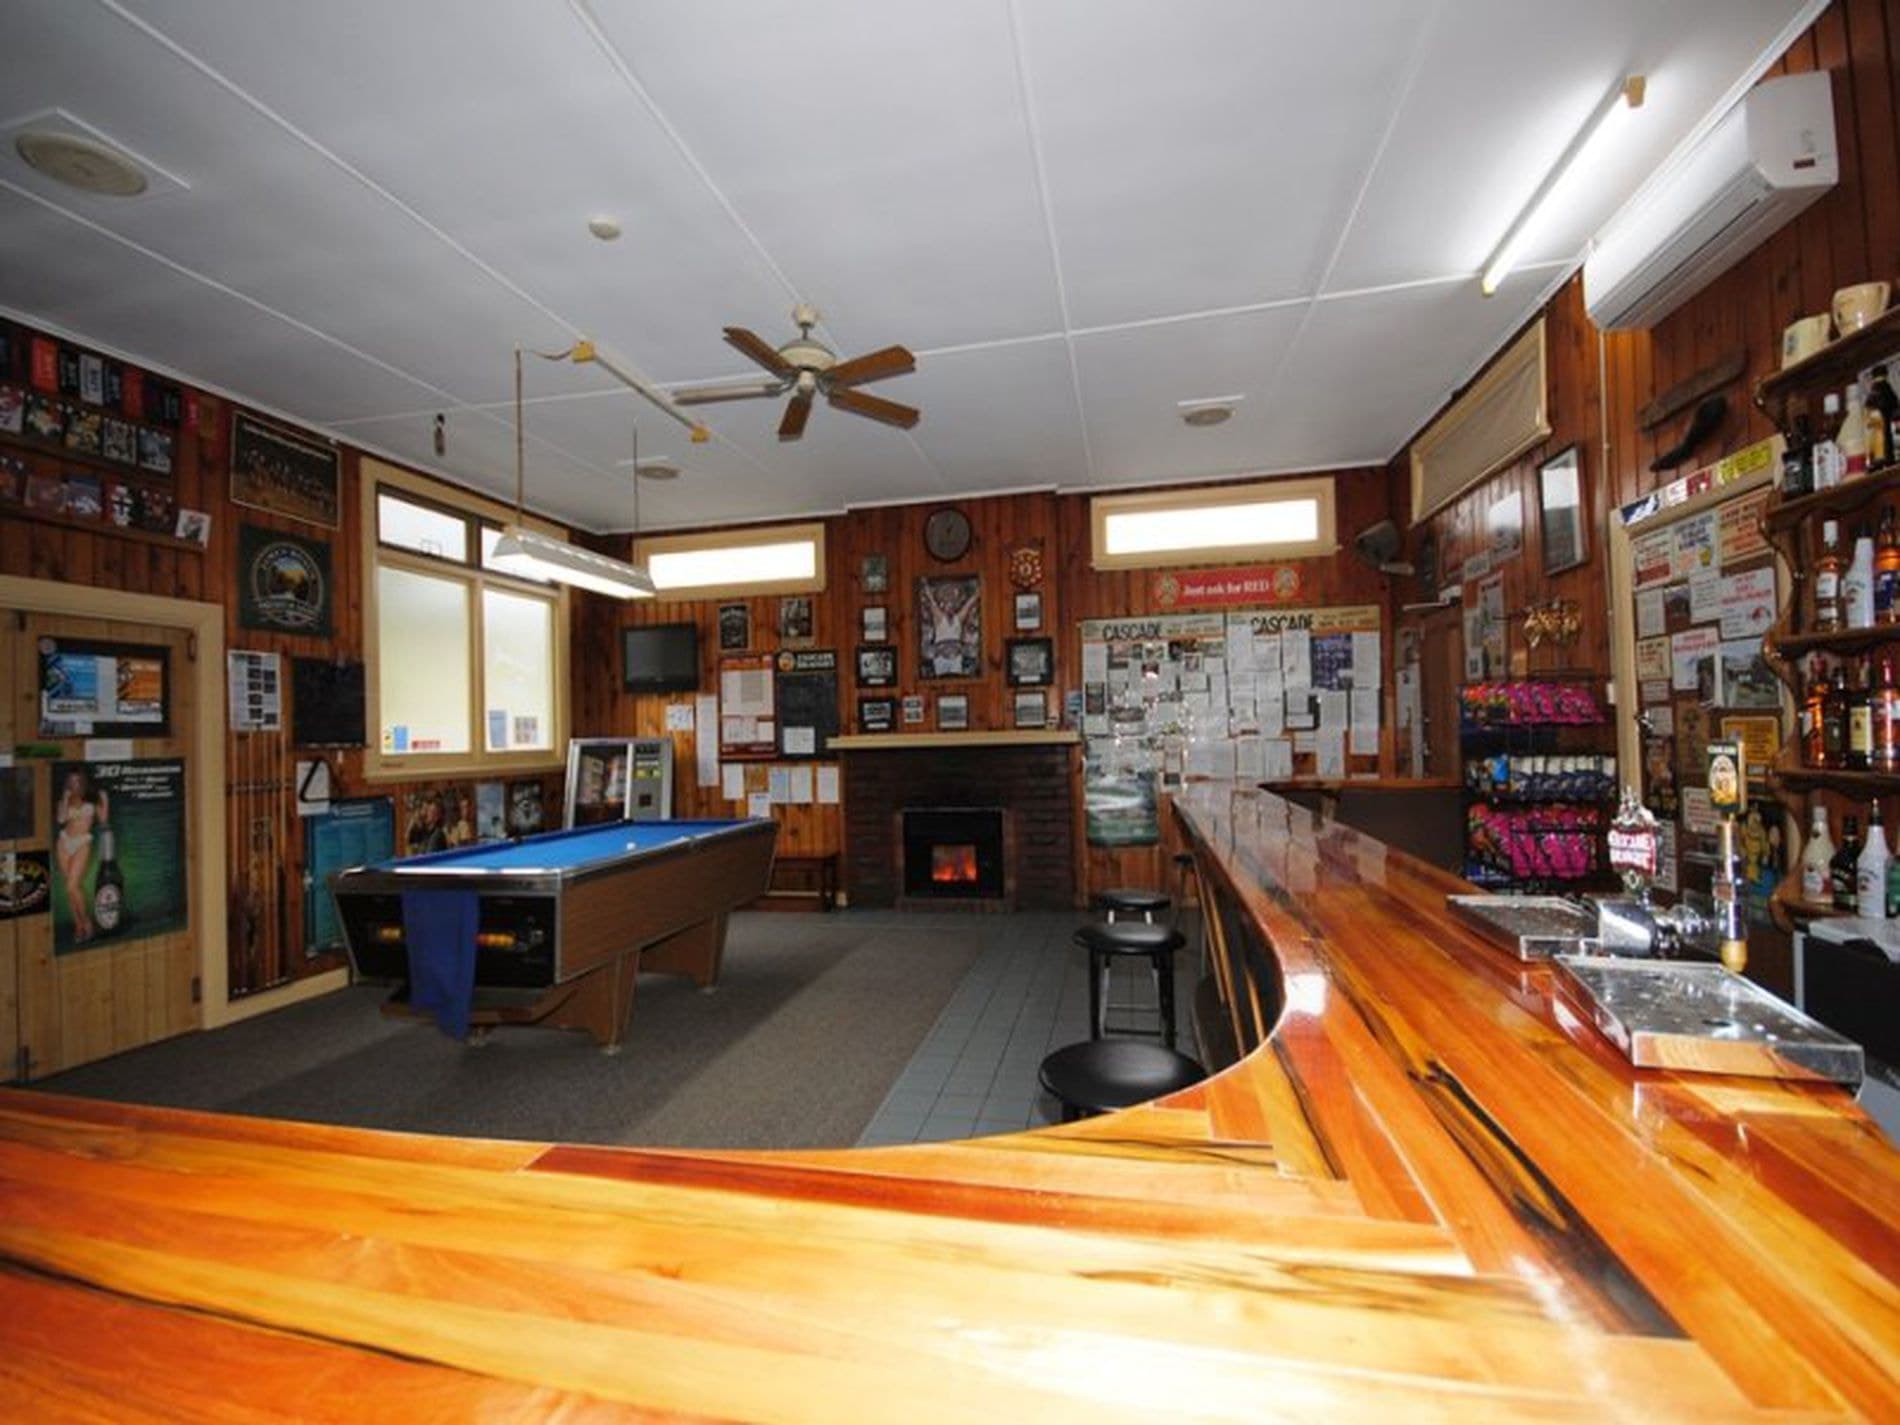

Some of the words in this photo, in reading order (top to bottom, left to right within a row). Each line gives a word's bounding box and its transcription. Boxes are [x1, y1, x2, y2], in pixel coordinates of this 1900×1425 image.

[1244, 580, 1269, 593] RED
[1102, 622, 1163, 642] CASCADE
[1250, 613, 1314, 636] CASCADE
